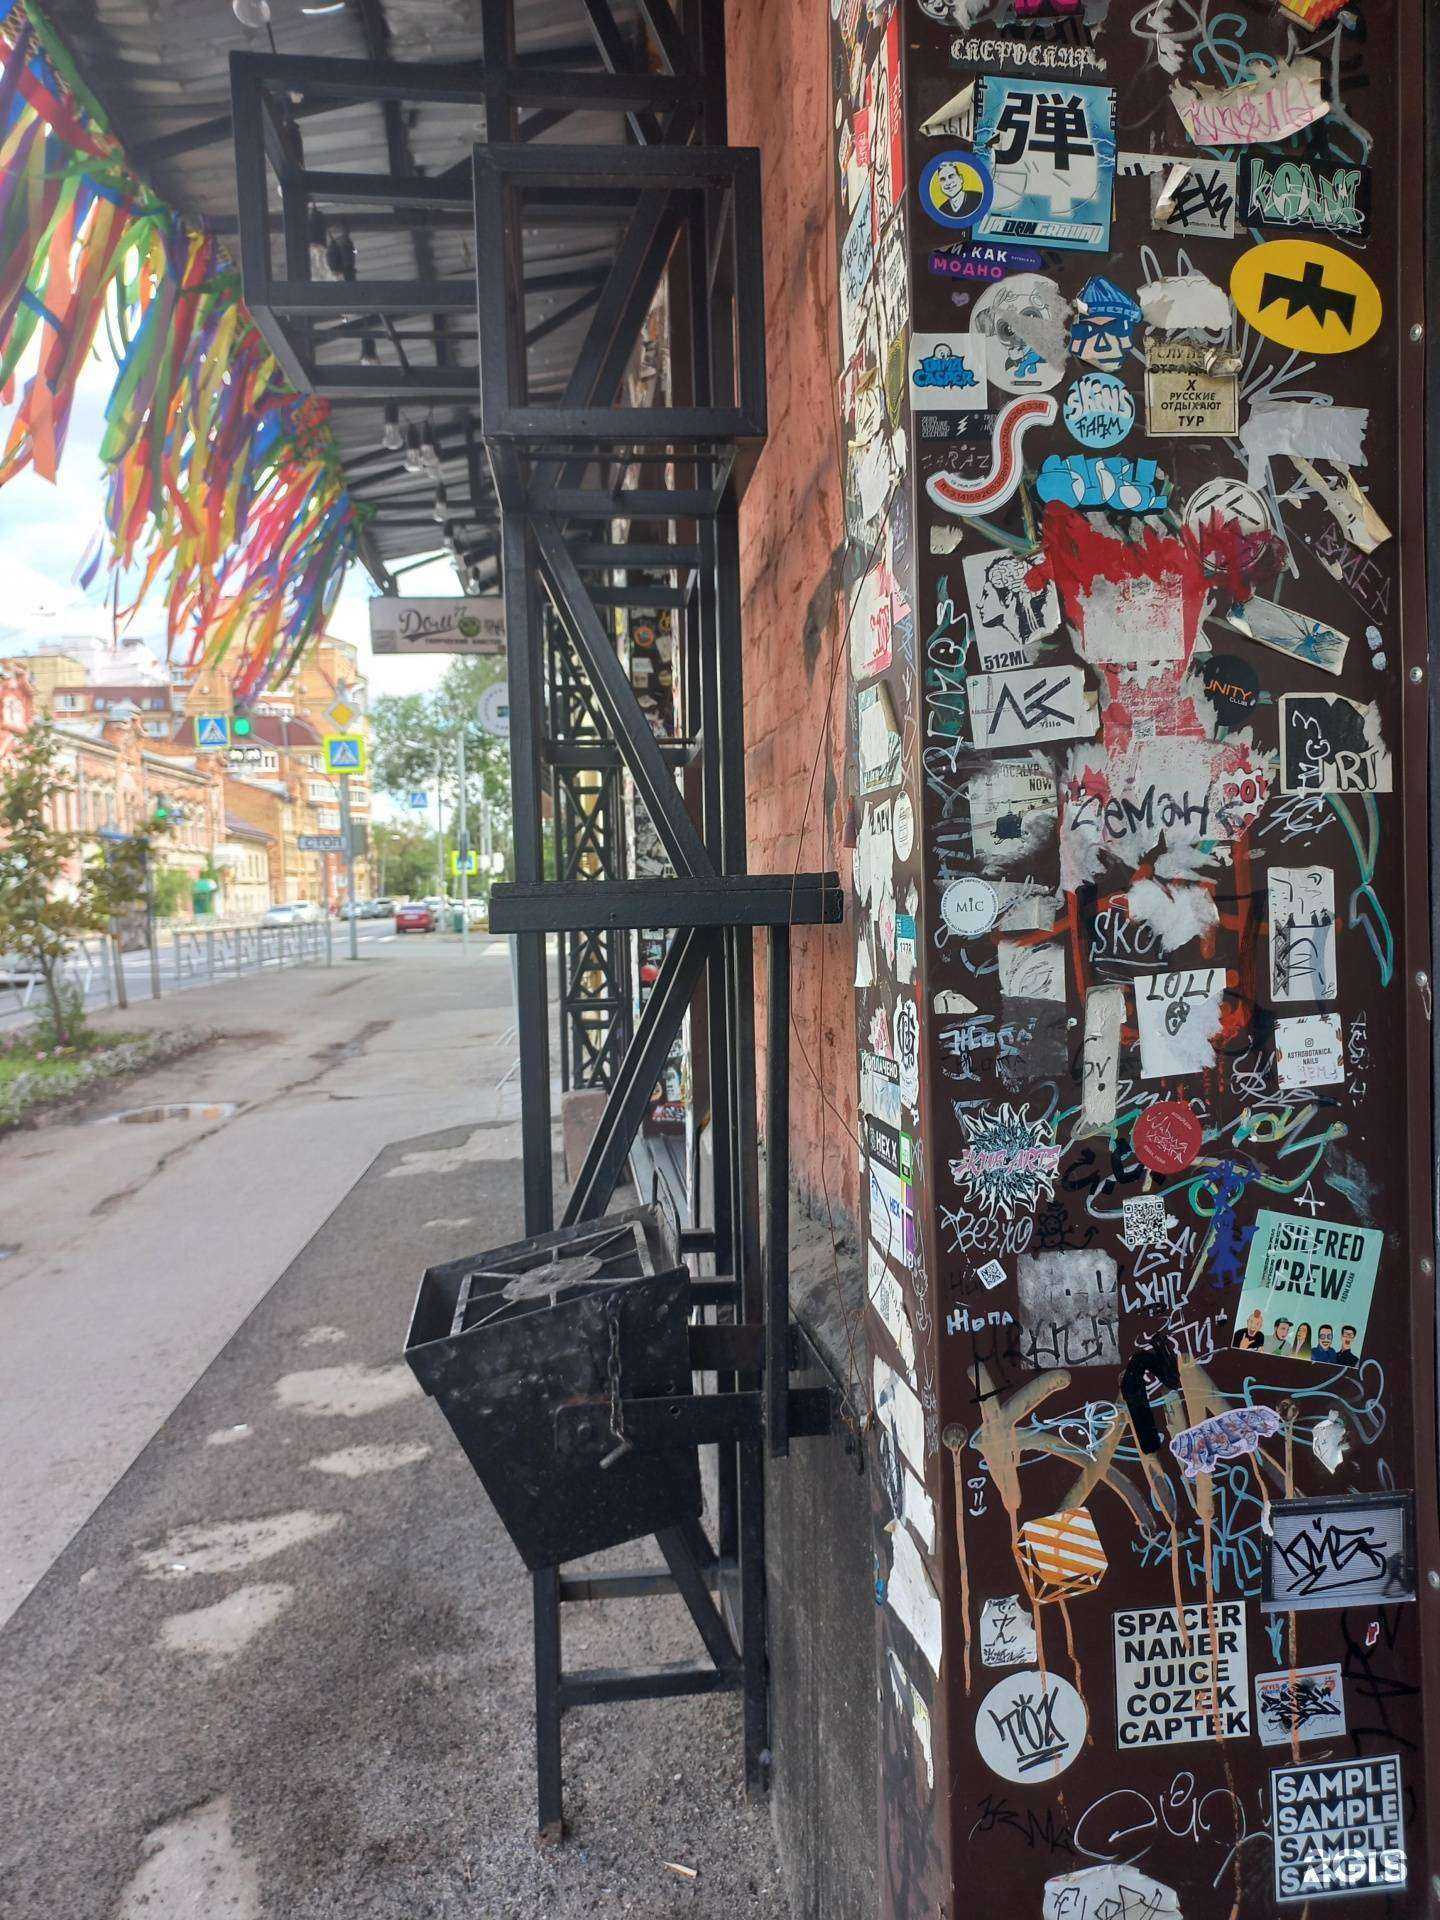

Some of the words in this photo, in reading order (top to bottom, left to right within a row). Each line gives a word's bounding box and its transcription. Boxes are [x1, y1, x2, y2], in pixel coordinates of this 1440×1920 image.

[934, 256, 1003, 279] МОДНО
[971, 246, 1009, 263] КАК
[1160, 401, 1222, 412] ОТДЫХАЮТ
[1169, 392, 1216, 401] РУССКИЕ
[1178, 415, 1205, 427] ТУР
[1280, 1224, 1365, 1262] SILFRED
[1274, 1257, 1348, 1301] CREW
[1117, 1604, 1241, 1637] SPACER
[1124, 1631, 1238, 1664] NAMER
[1133, 1659, 1230, 1690] JUICE
[1126, 1685, 1237, 1717] COZEK
[1119, 1711, 1249, 1745] CAPTEK
[1277, 1762, 1397, 1803] SAMPLE
[1278, 1794, 1398, 1834] SAMPLE
[1280, 1824, 1399, 1864] SAMPLE
